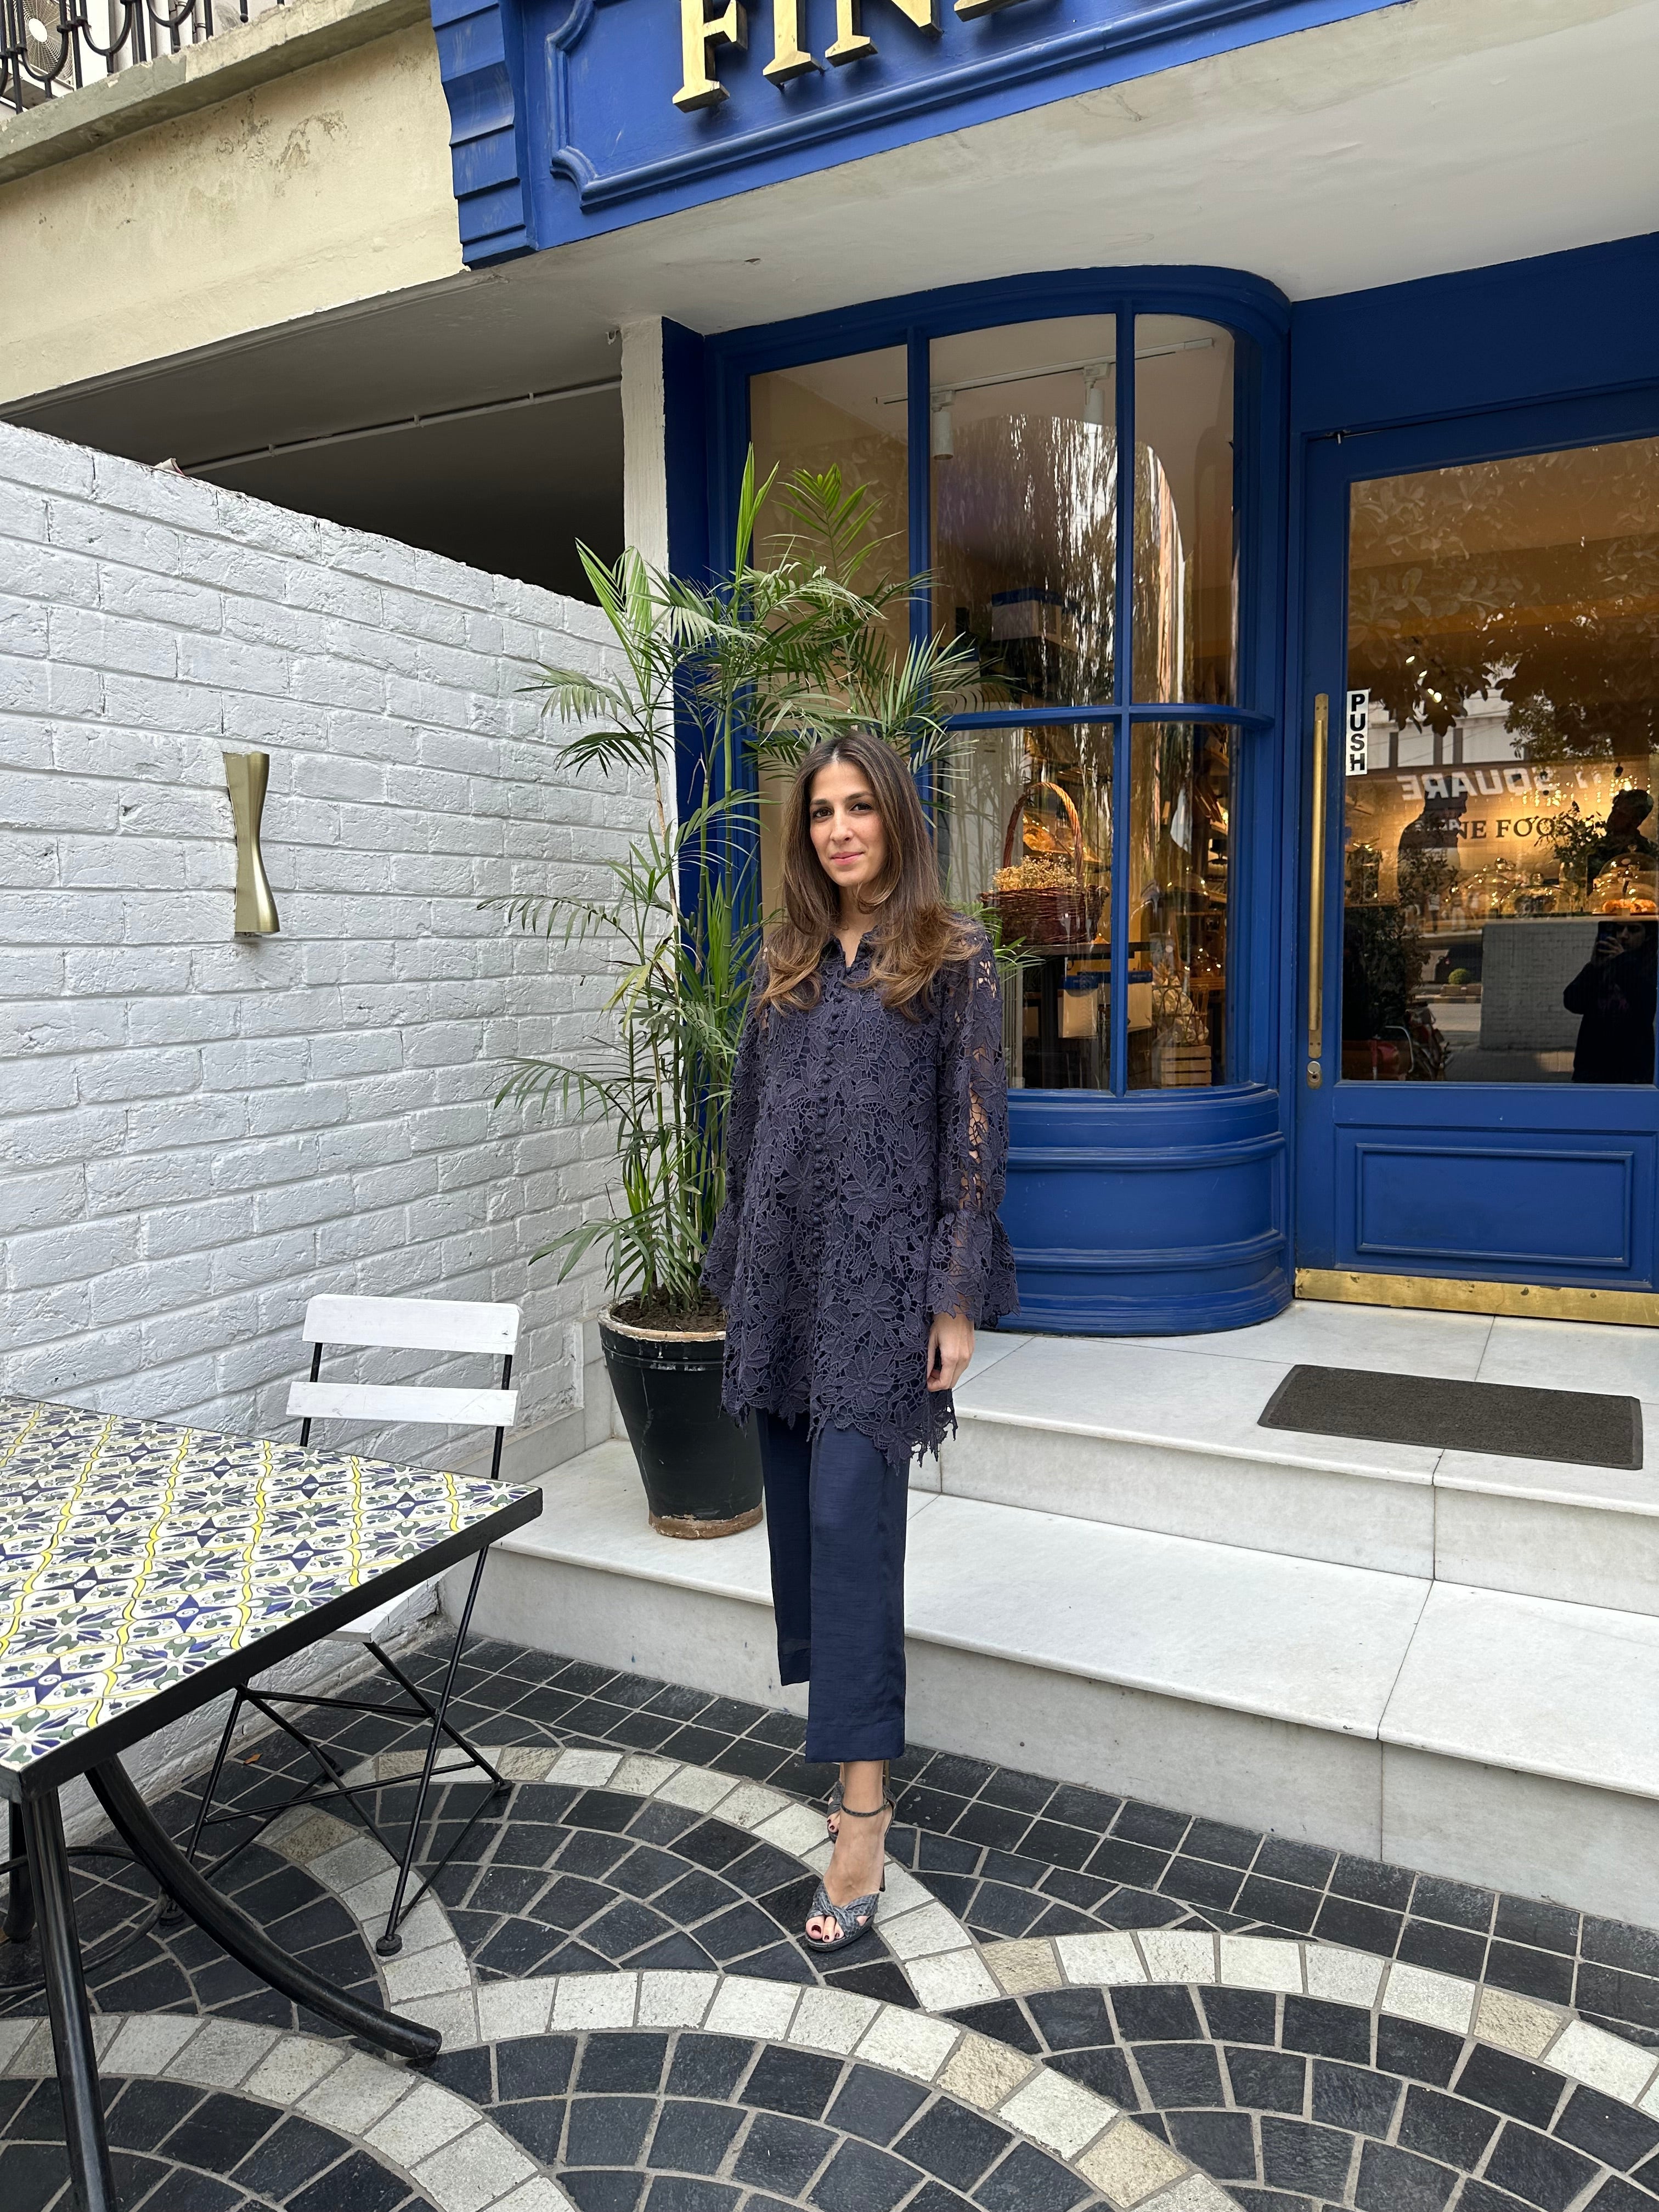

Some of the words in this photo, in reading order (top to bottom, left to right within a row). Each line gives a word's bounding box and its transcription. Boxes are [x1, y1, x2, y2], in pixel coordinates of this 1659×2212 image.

[673, 0, 1012, 113] FIN
[1350, 693, 1365, 771] PUSH
[1496, 816, 1558, 838] FOO
